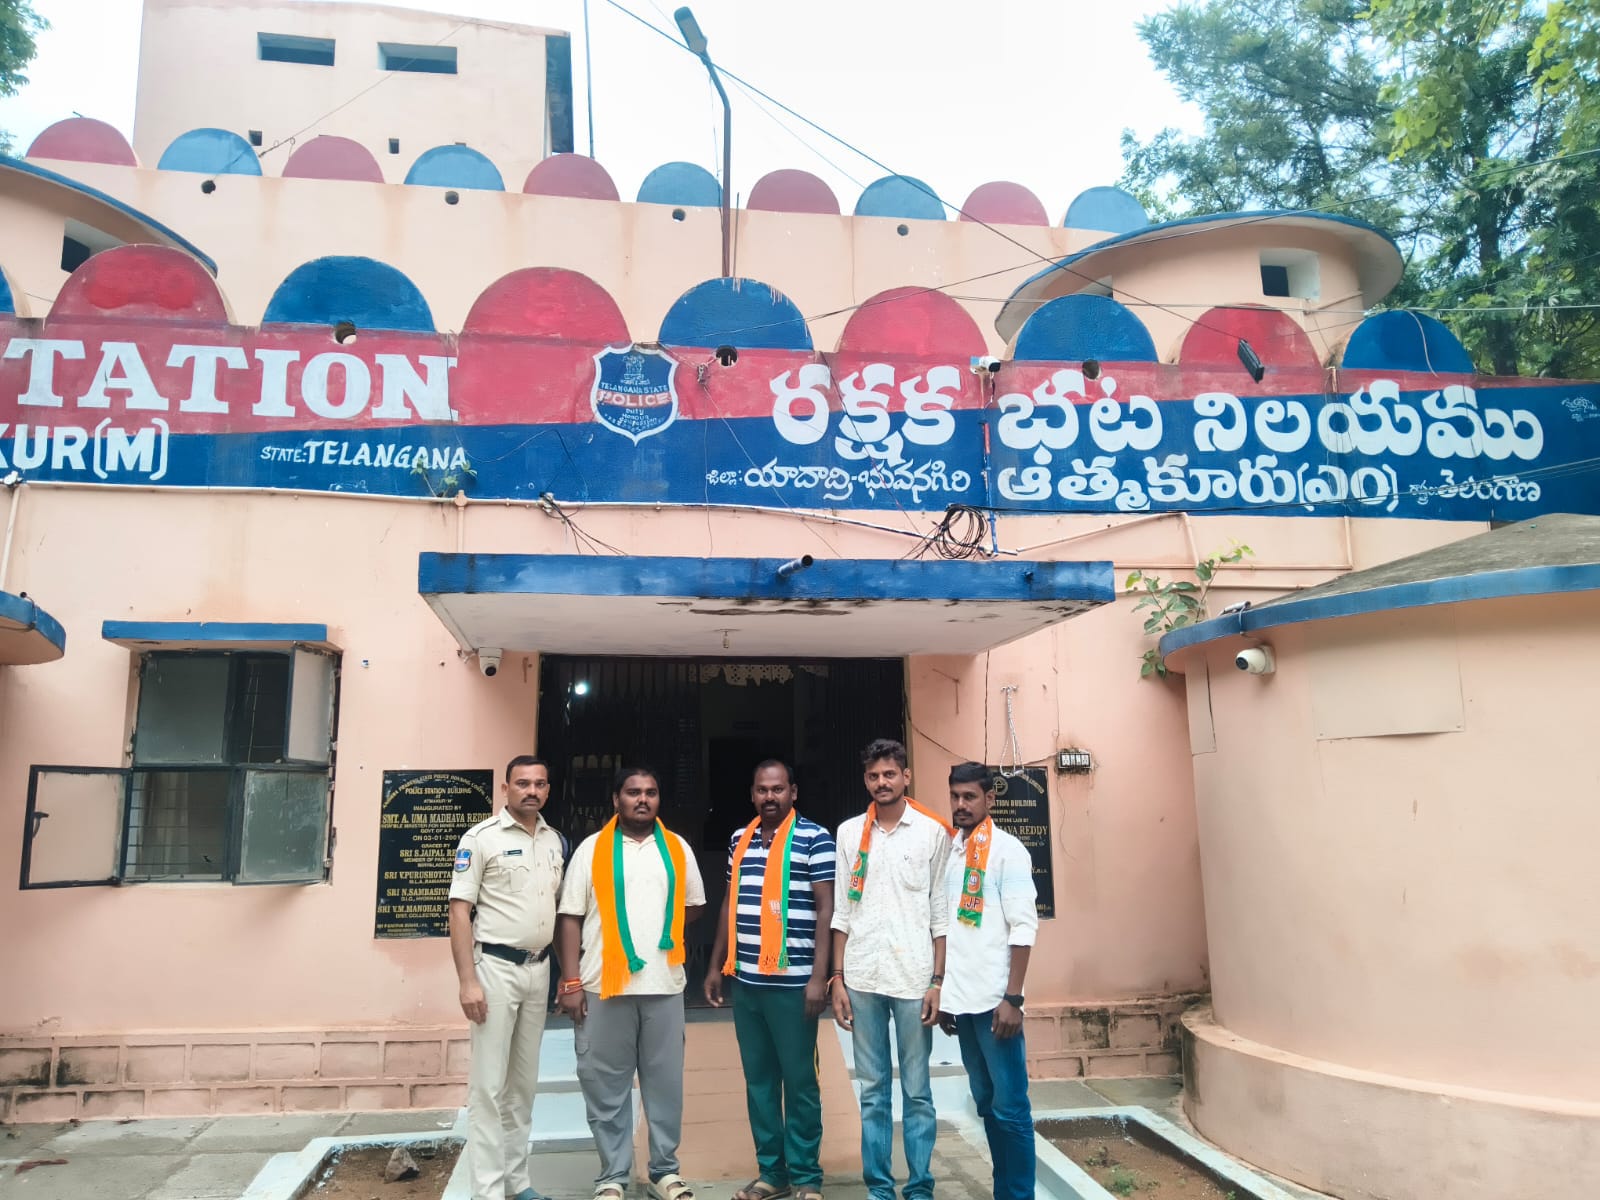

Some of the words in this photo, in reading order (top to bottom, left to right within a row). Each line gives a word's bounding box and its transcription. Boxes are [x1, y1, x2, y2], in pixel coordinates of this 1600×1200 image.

[643, 385, 668, 393] STATE
[599, 389, 669, 406] POLICE
[769, 363, 961, 466] రక్షక
[1193, 379, 1544, 460] నిలయము
[0, 417, 168, 480] UR(M)
[405, 787, 423, 795] POLICE
[423, 787, 446, 795] STATION
[1010, 799, 1037, 808] BUILDING
[401, 813, 410, 823] A.
[411, 813, 427, 823] UMA
[430, 813, 465, 823] MADHAVA
[1019, 825, 1048, 835] REDDY
[400, 849, 413, 858] SRI
[414, 849, 445, 857] S.JAIPAL
[384, 871, 397, 880] SRI
[399, 871, 452, 879] V.PURUSHOTTA
[387, 888, 400, 897] SRI
[401, 888, 450, 897] N.SAMBASIVA
[378, 905, 391, 913] SRI
